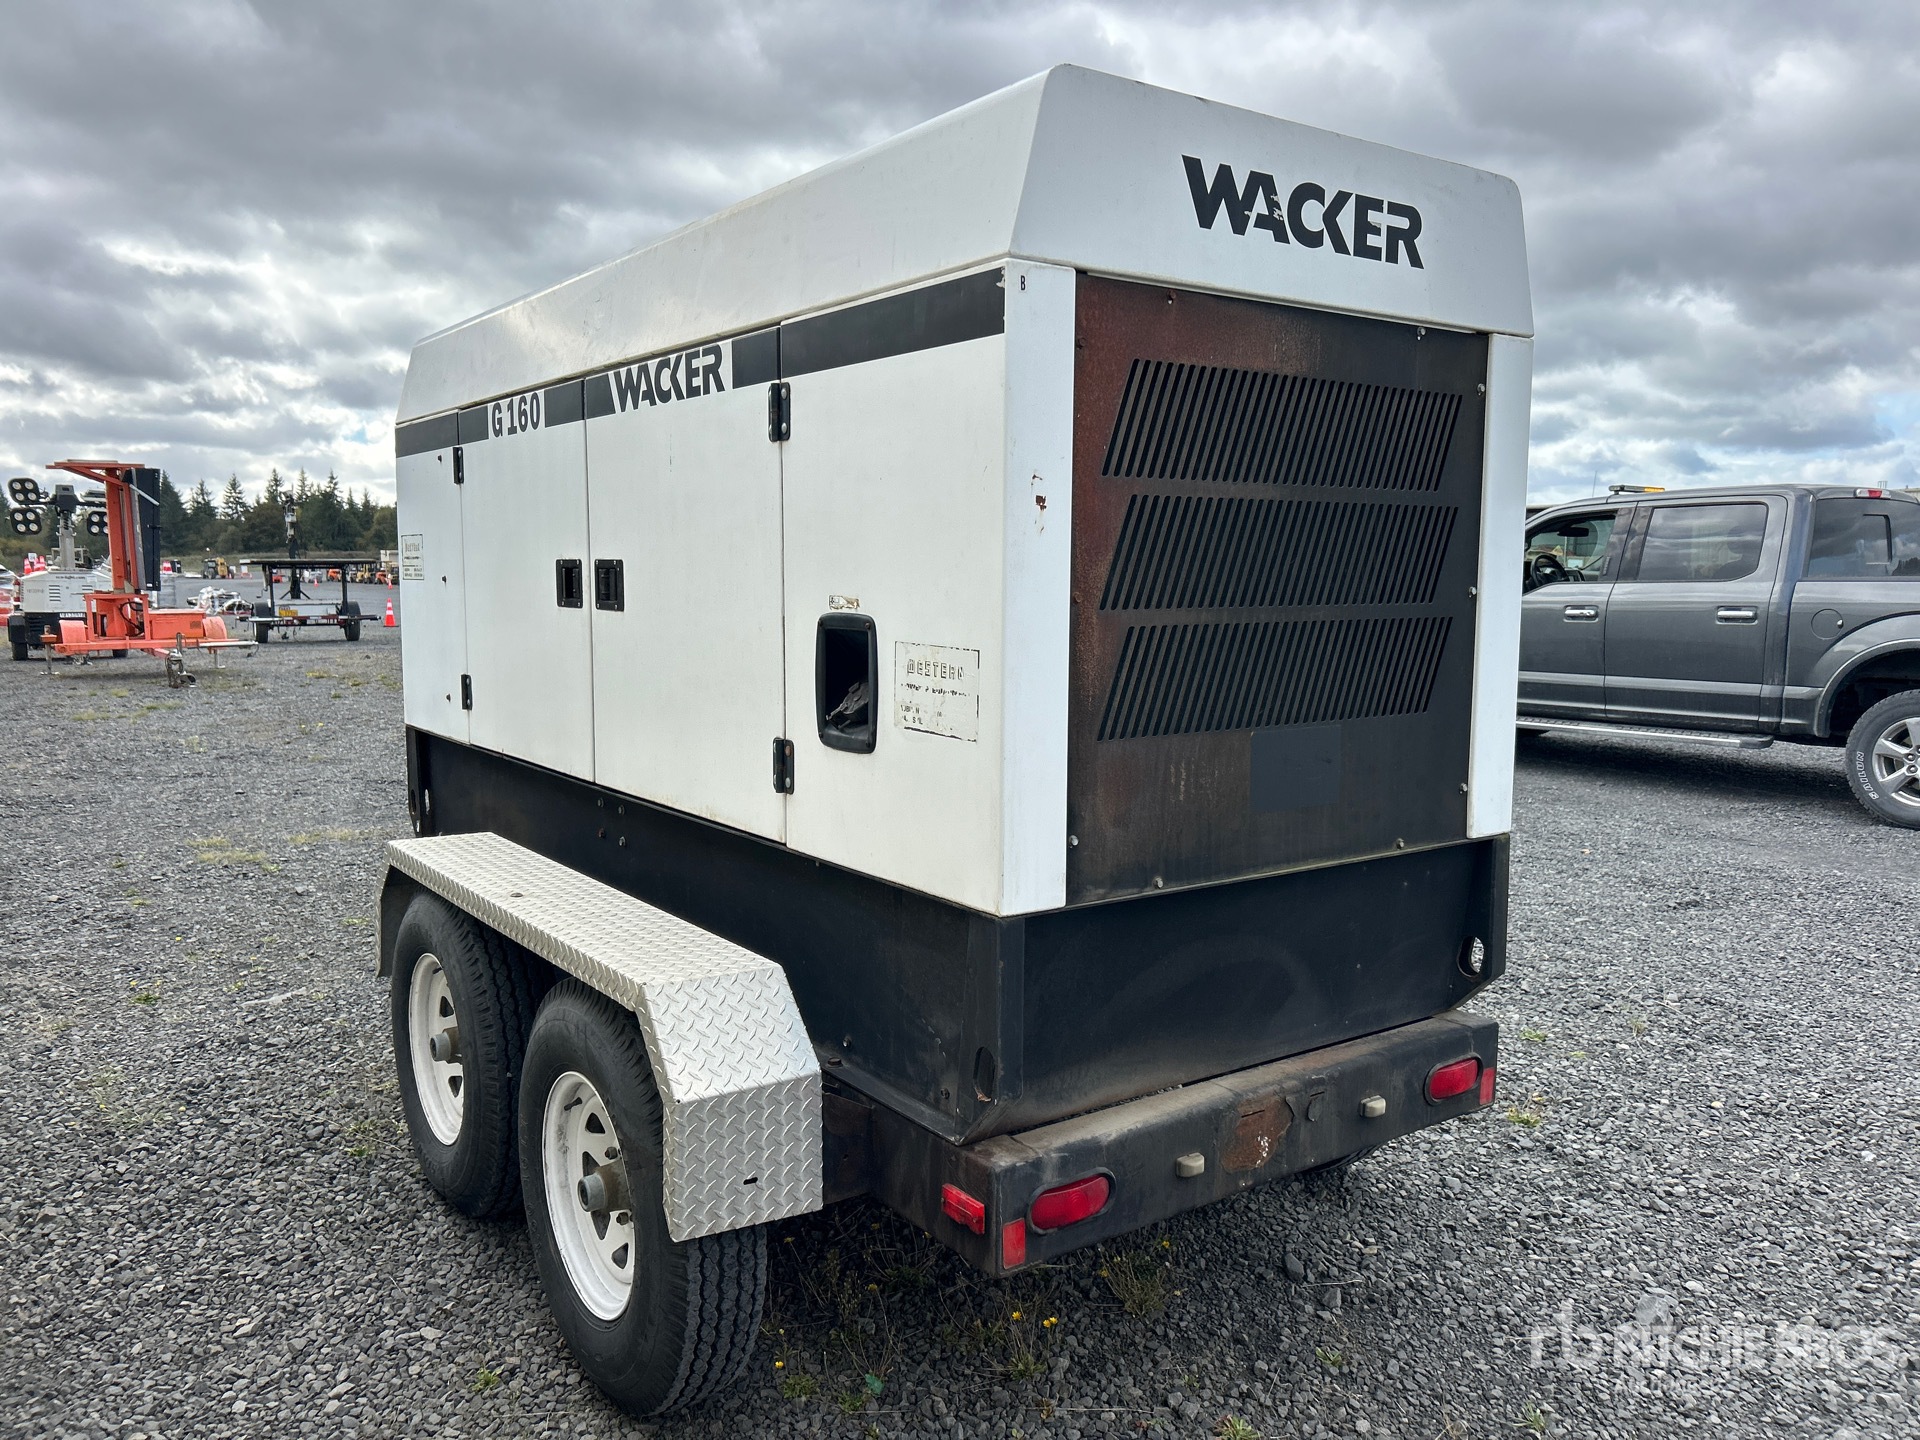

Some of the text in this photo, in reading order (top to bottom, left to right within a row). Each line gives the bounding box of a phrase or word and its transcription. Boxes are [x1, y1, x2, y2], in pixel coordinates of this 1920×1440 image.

[1181, 154, 1424, 269] WACKER
[1020, 275, 1026, 291] B
[614, 344, 725, 413] WACKER
[491, 391, 541, 438] G 160
